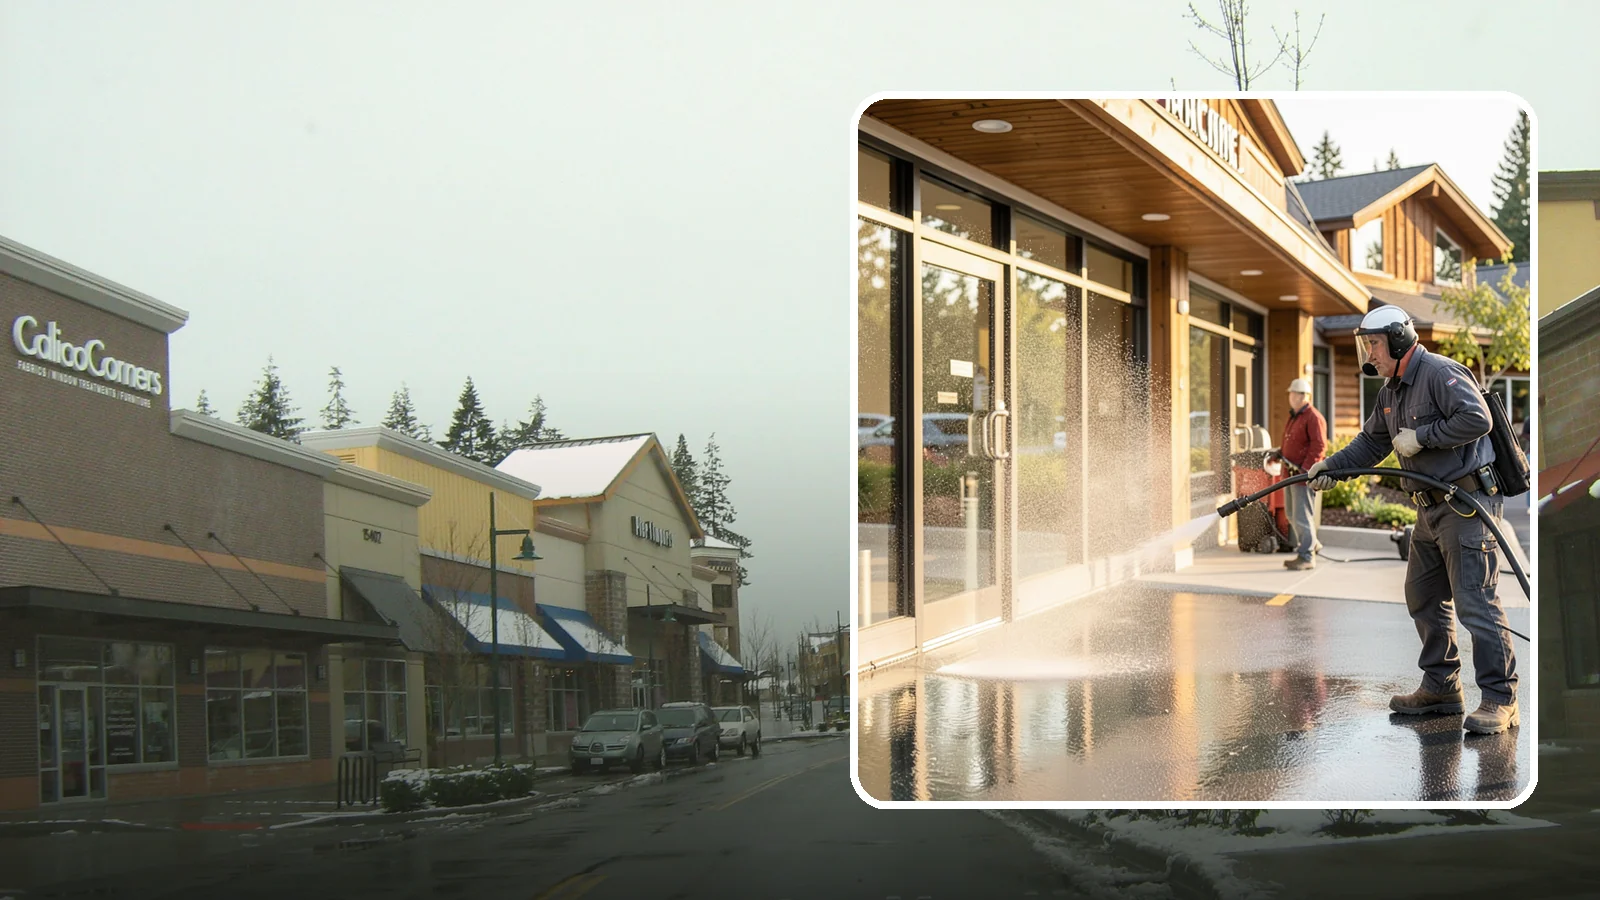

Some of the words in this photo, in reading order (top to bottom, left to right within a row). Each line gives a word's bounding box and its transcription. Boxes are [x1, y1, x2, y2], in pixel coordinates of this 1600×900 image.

[17, 359, 47, 378] FABRICS
[51, 370, 78, 386] WINDOW
[79, 378, 116, 398] TREATMENTS
